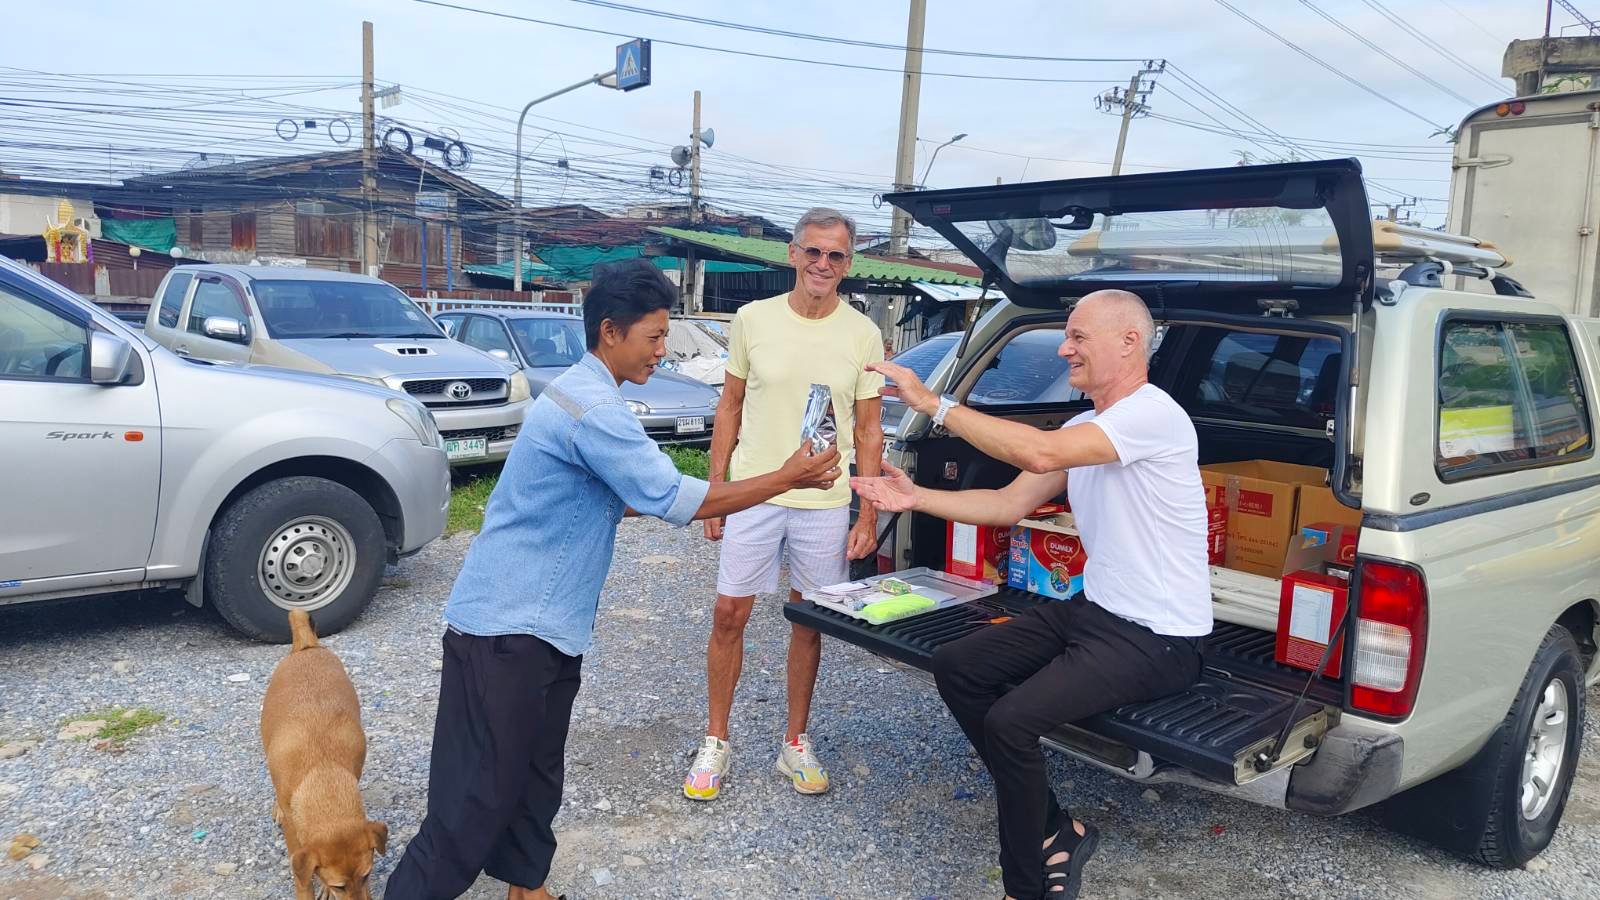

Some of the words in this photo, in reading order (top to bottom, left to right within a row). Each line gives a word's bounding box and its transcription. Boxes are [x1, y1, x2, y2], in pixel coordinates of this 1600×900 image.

[45, 431, 115, 441] Spark
[463, 439, 485, 450] 3449
[1050, 542, 1074, 554] DUMEX
